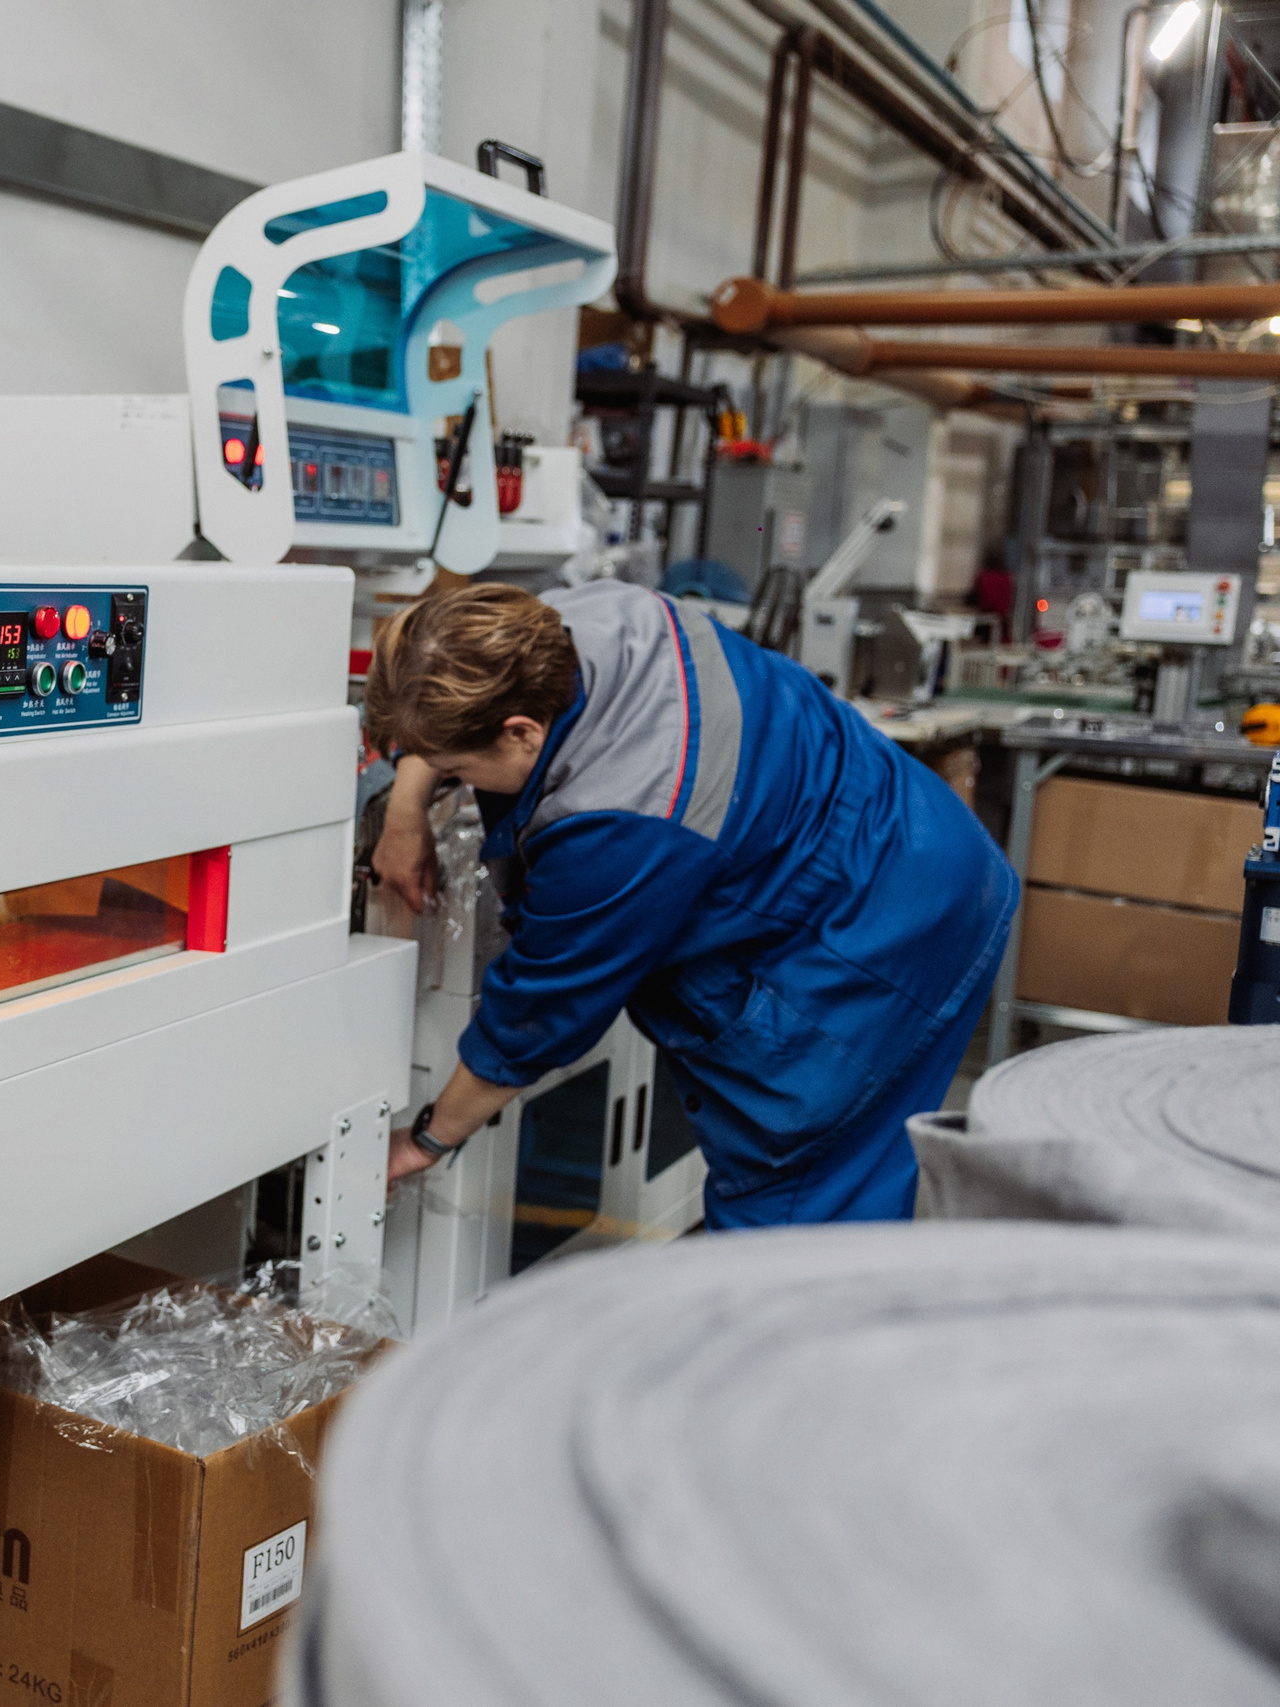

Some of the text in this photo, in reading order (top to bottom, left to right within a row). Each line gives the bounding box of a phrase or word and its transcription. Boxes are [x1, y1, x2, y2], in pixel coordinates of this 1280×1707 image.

[0, 625, 21, 645] 153
[8, 648, 20, 659] 153
[252, 1535, 296, 1579] F150
[8, 1662, 62, 1704] 24KG
